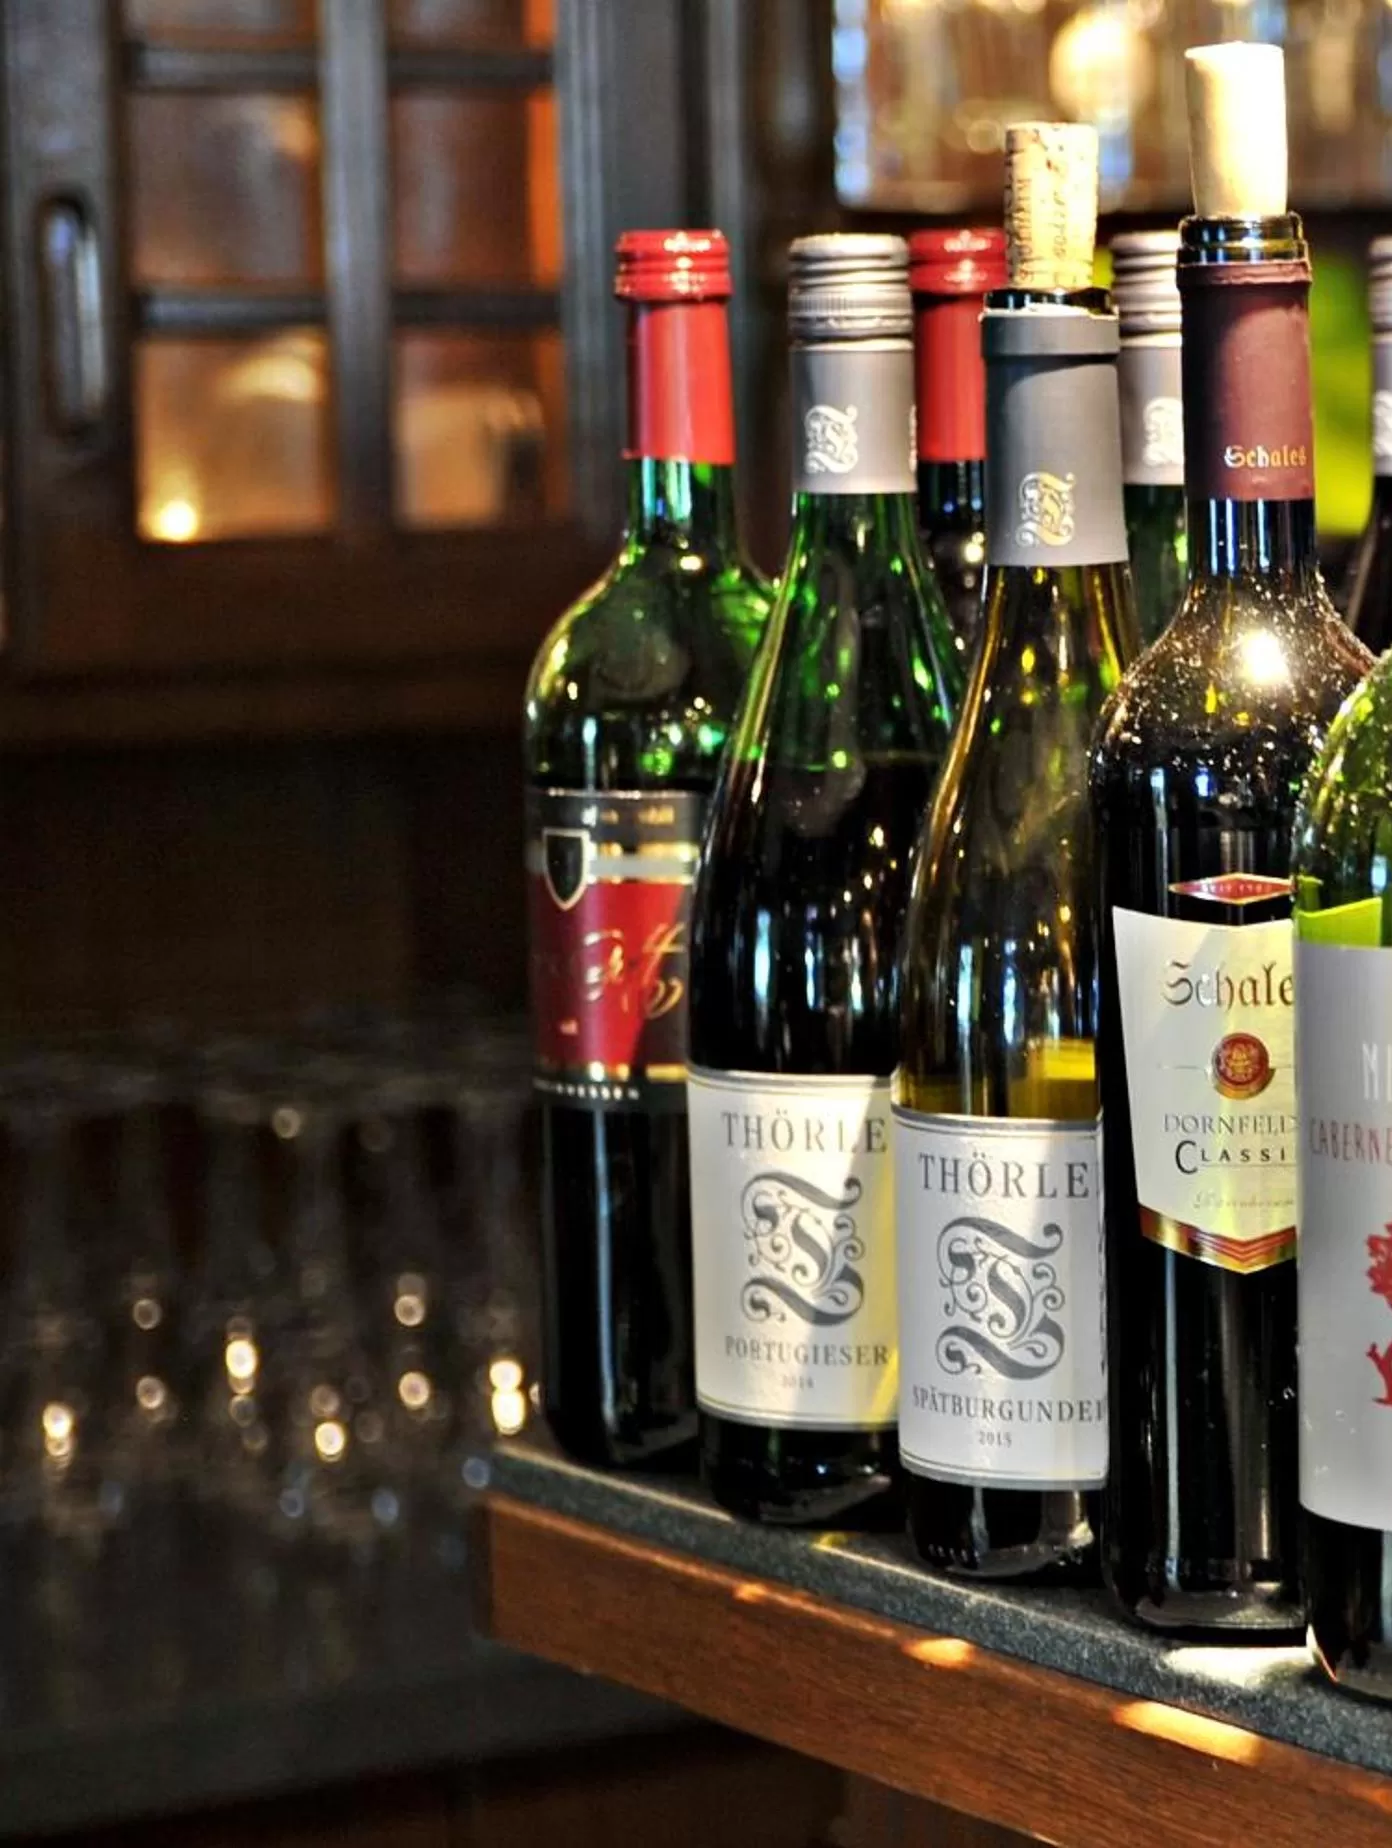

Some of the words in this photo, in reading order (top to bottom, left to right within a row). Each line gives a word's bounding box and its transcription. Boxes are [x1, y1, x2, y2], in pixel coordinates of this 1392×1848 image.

[1163, 960, 1293, 1013] Schale
[720, 1107, 888, 1153] THÖRLE
[918, 1150, 1090, 1199] THÖRLE
[1174, 1139, 1287, 1175] CLASSI
[724, 1335, 889, 1367] PORTUGIESER
